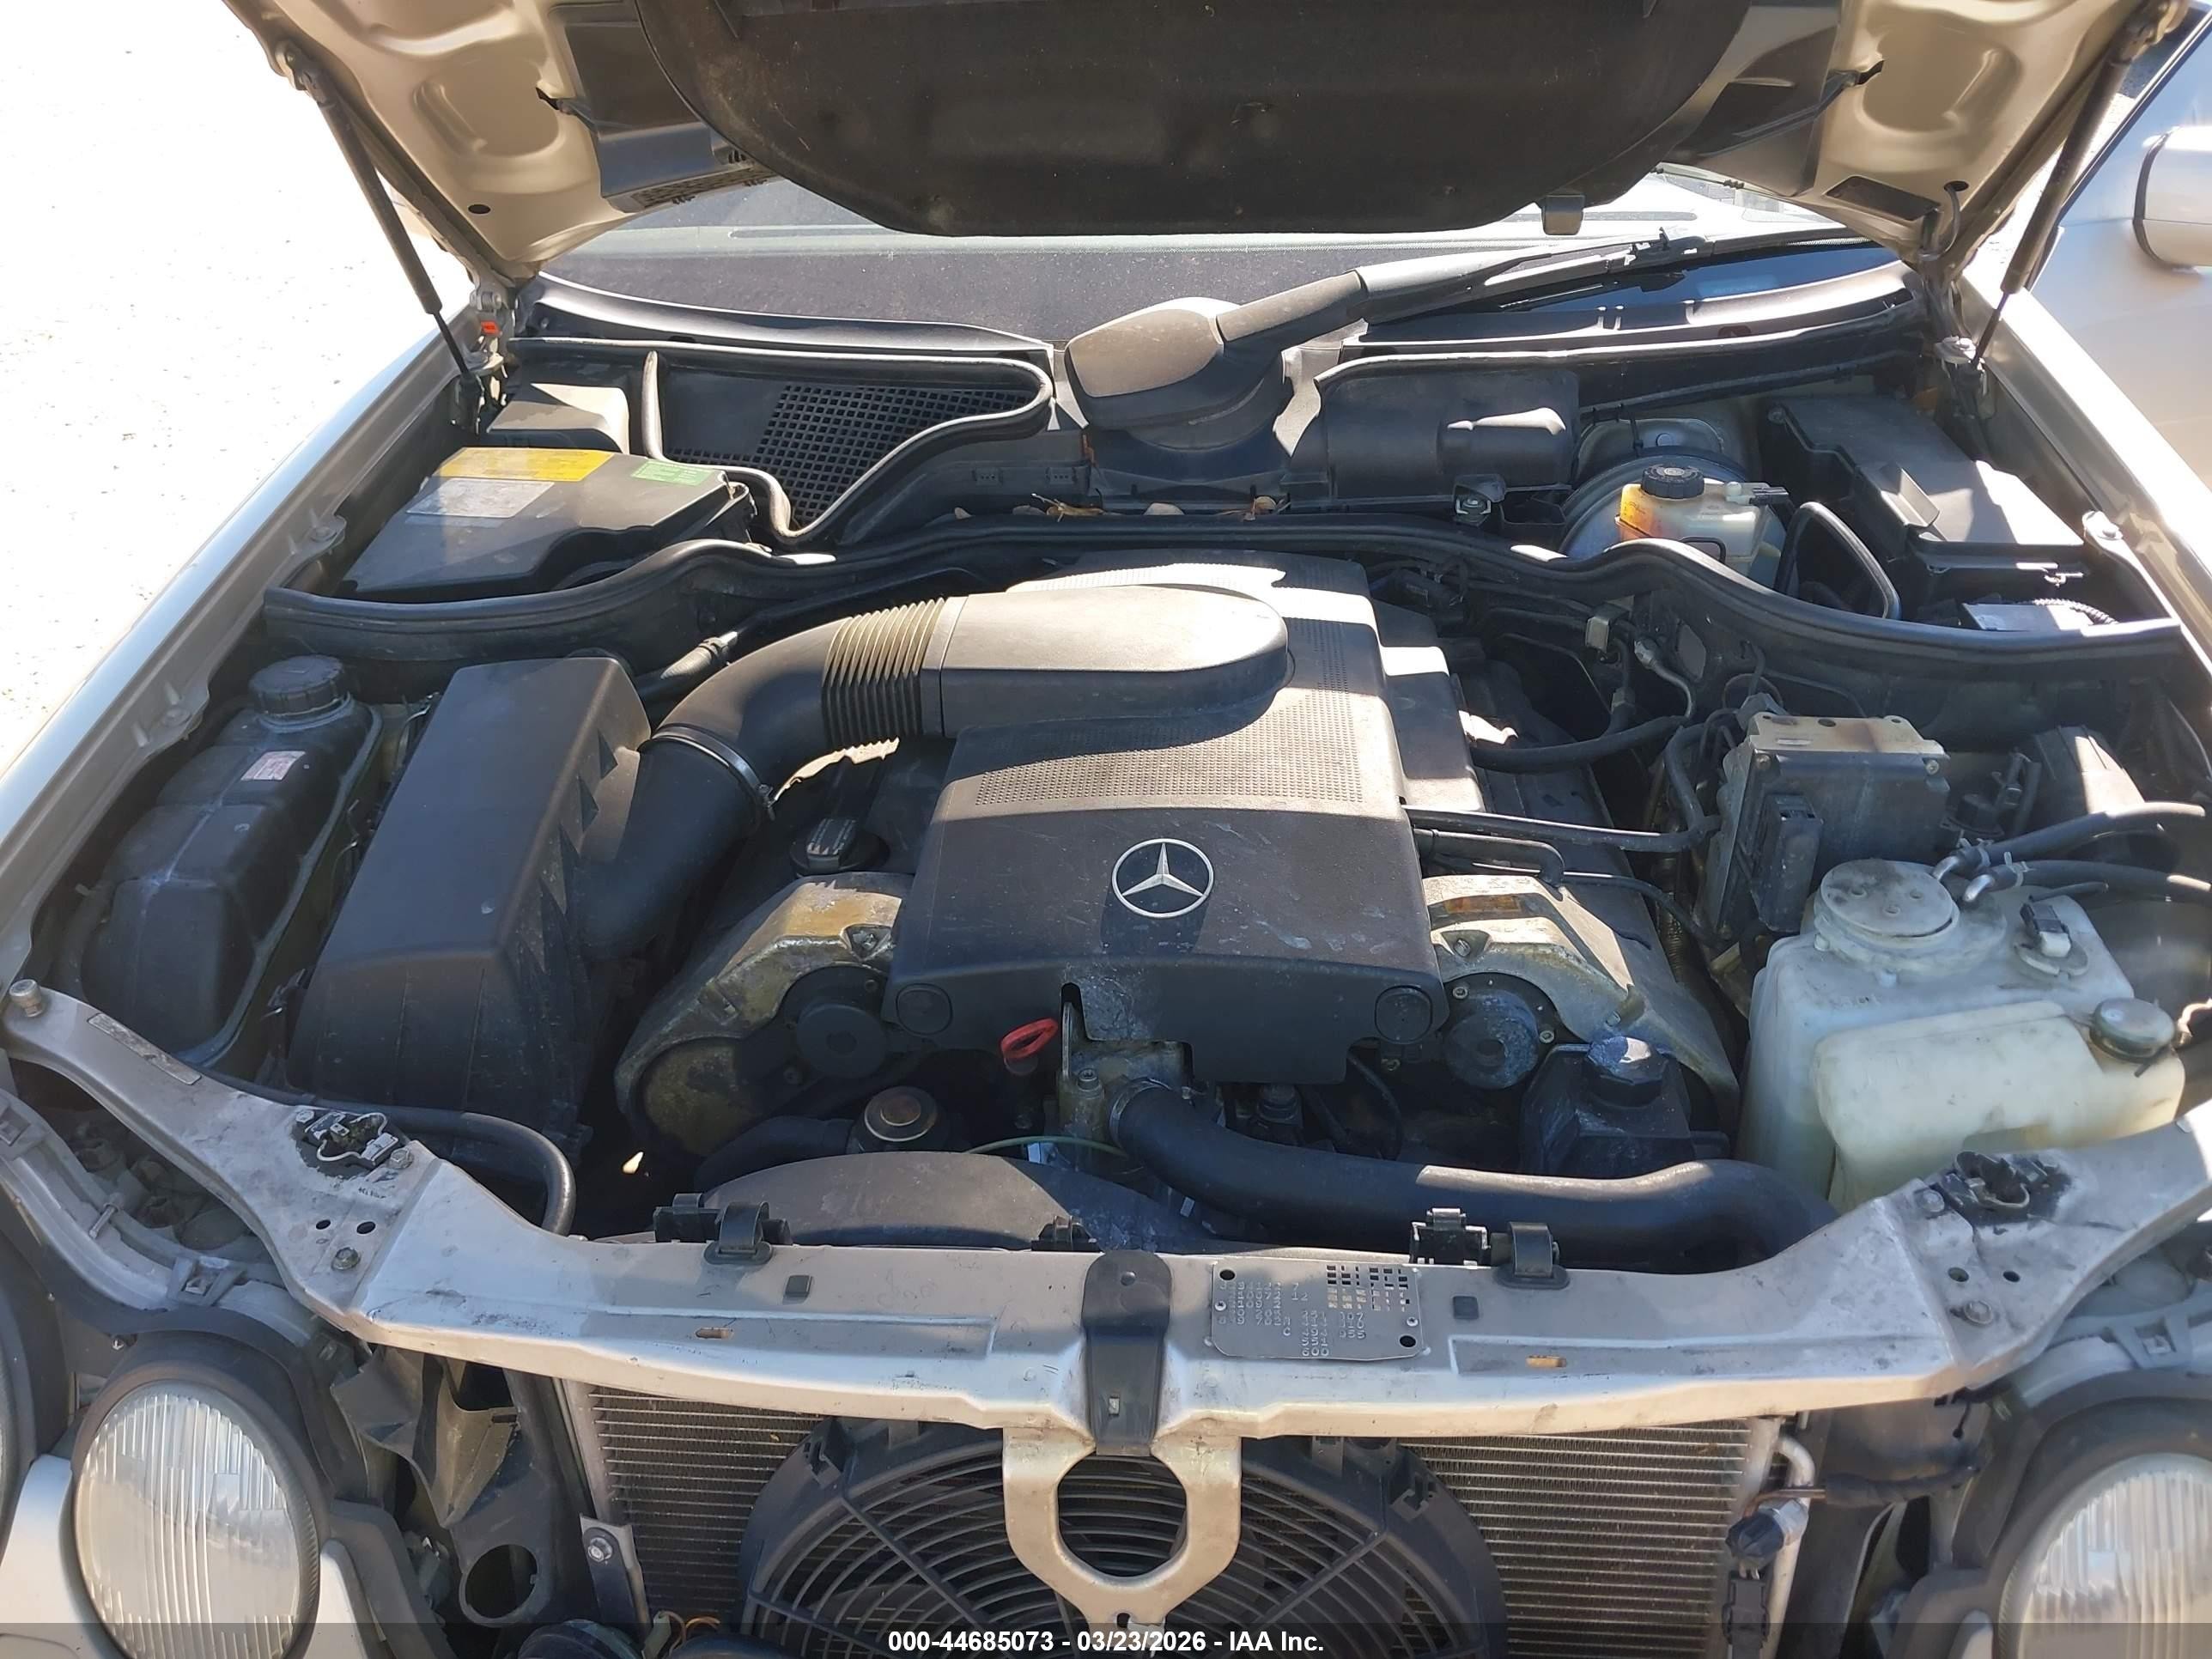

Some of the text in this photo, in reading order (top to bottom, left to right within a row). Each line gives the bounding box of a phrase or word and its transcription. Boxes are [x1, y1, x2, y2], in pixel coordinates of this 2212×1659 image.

[1291, 1291, 1309, 1301] 12
[1301, 1337, 1328, 1346] 551
[1302, 1346, 1330, 1357] 600
